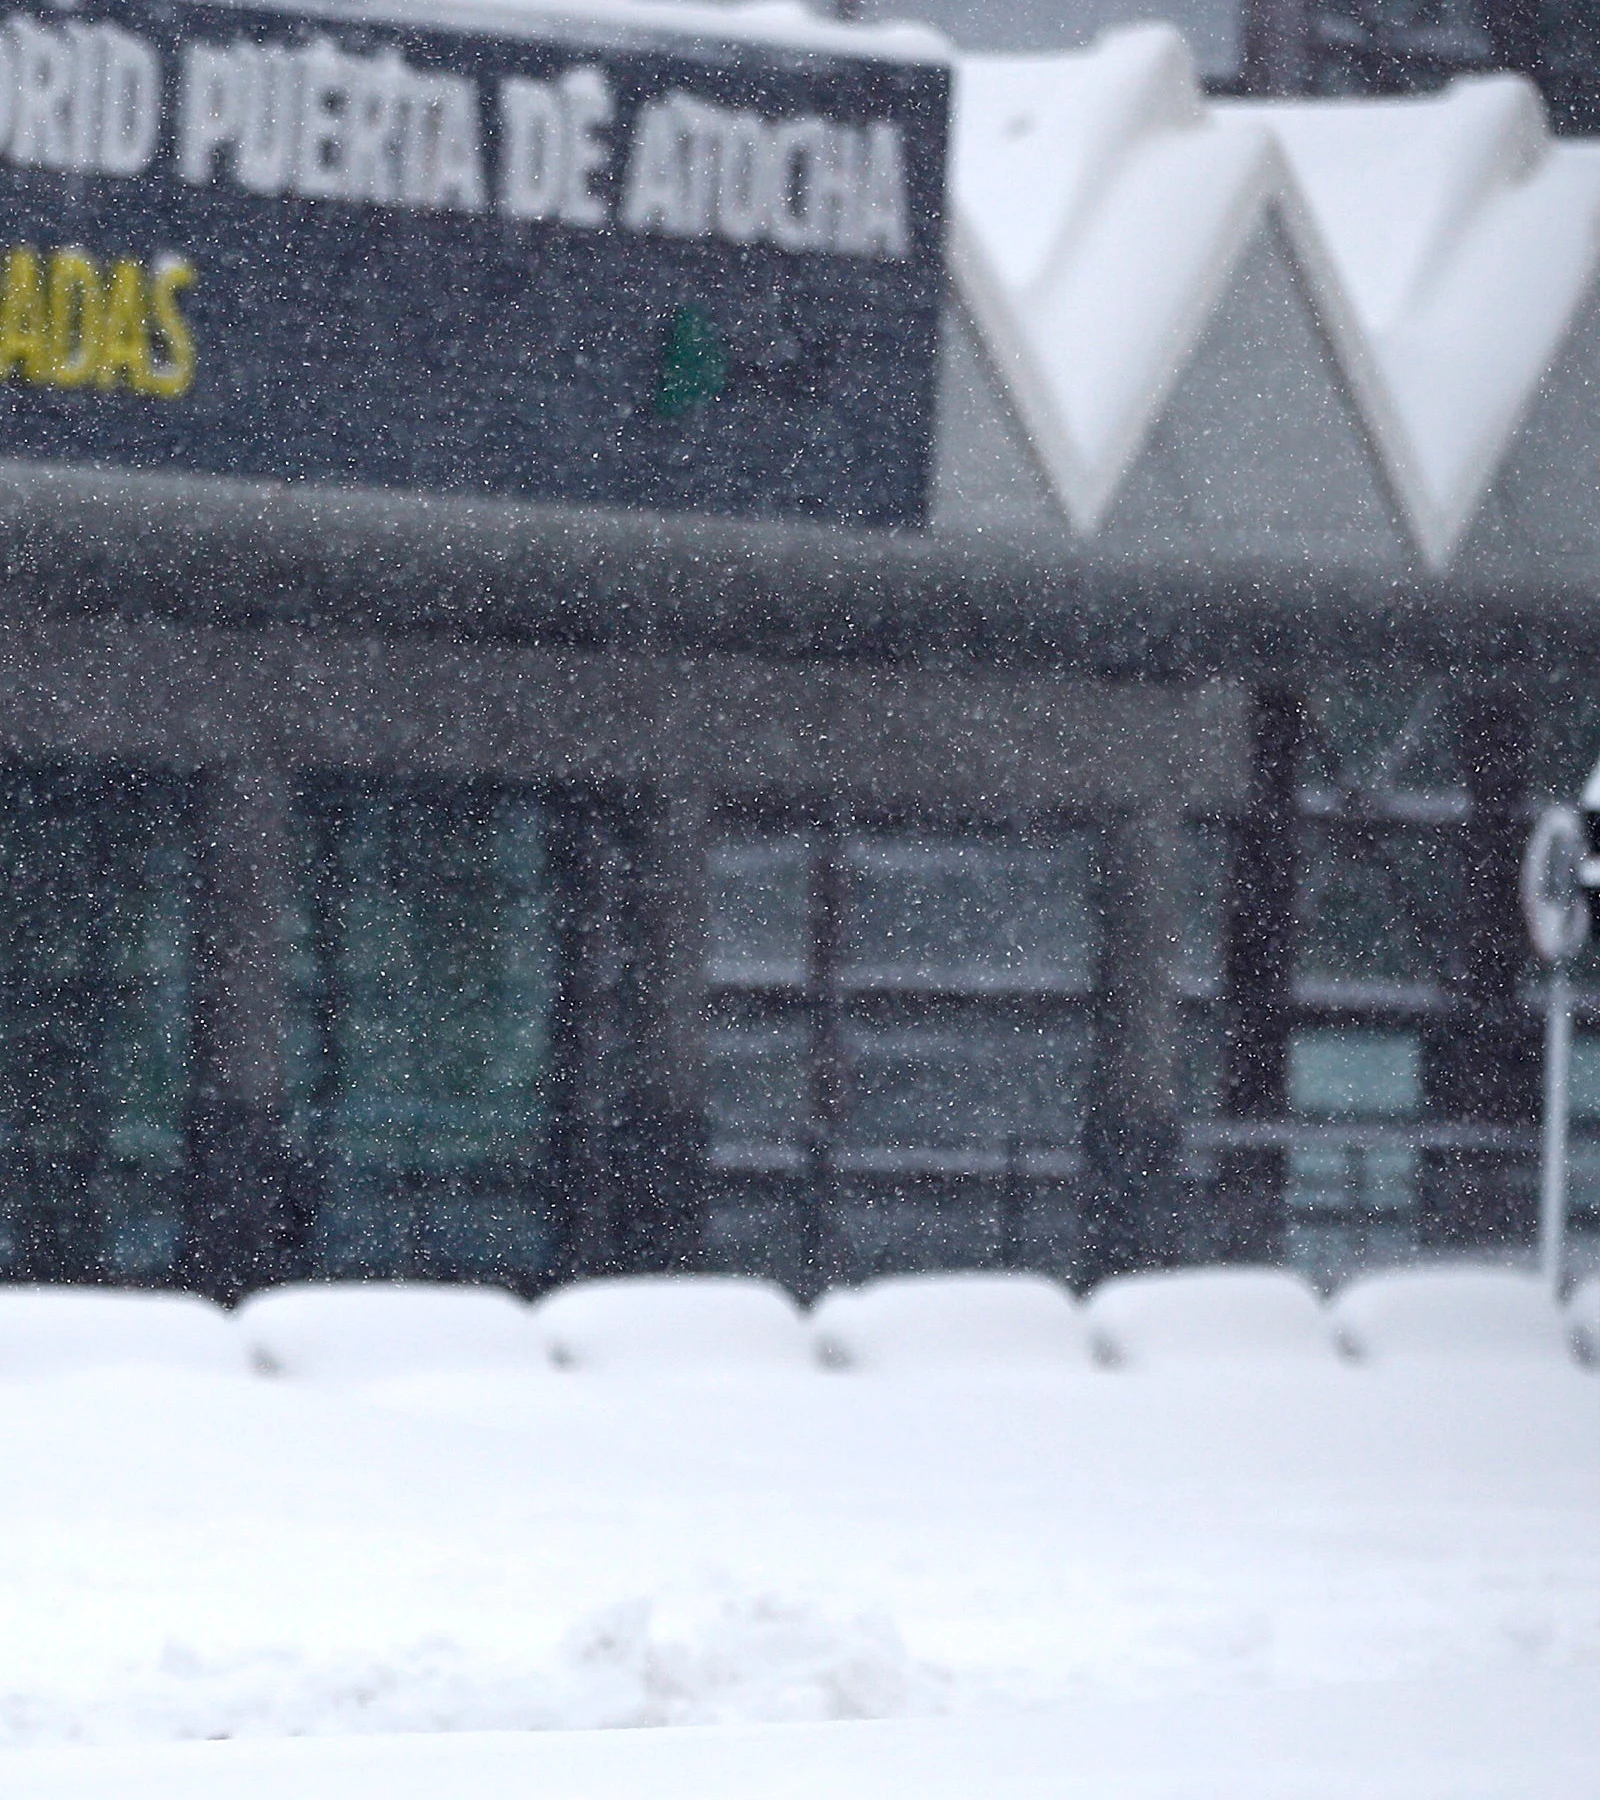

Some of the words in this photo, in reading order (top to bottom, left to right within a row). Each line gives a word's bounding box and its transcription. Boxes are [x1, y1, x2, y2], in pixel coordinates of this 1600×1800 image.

[178, 42, 485, 212] PUERTA
[504, 70, 609, 228] DE
[620, 94, 910, 257] ATOCHA
